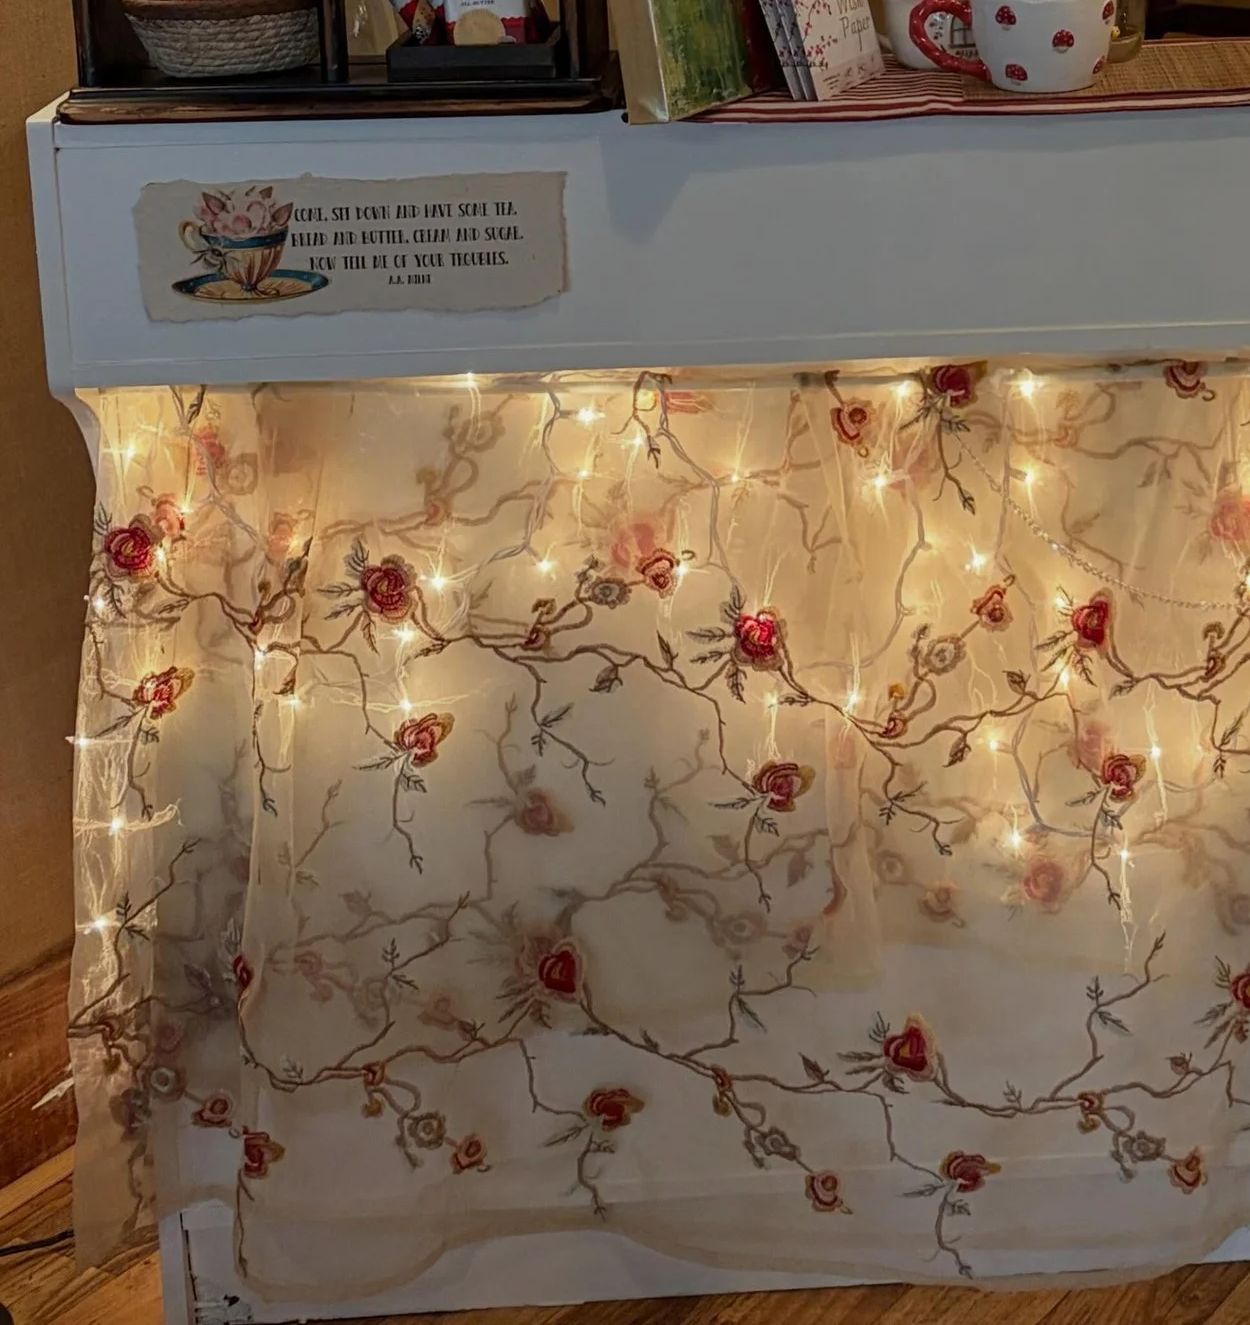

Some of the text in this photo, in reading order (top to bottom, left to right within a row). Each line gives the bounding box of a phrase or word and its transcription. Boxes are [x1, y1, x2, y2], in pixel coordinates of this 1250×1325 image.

[839, 16, 870, 52] Paper
[331, 206, 350, 222] SIT
[356, 205, 391, 220] DOWN
[396, 204, 420, 219] AND
[424, 203, 454, 218] HAVE
[458, 202, 489, 217] SOME
[291, 231, 328, 247] BREAD
[333, 230, 357, 246] AND
[413, 228, 451, 243] CREAM
[456, 227, 480, 242] AND
[310, 251, 509, 271] NOW TELL ME OF YOUR TROUBLES.
